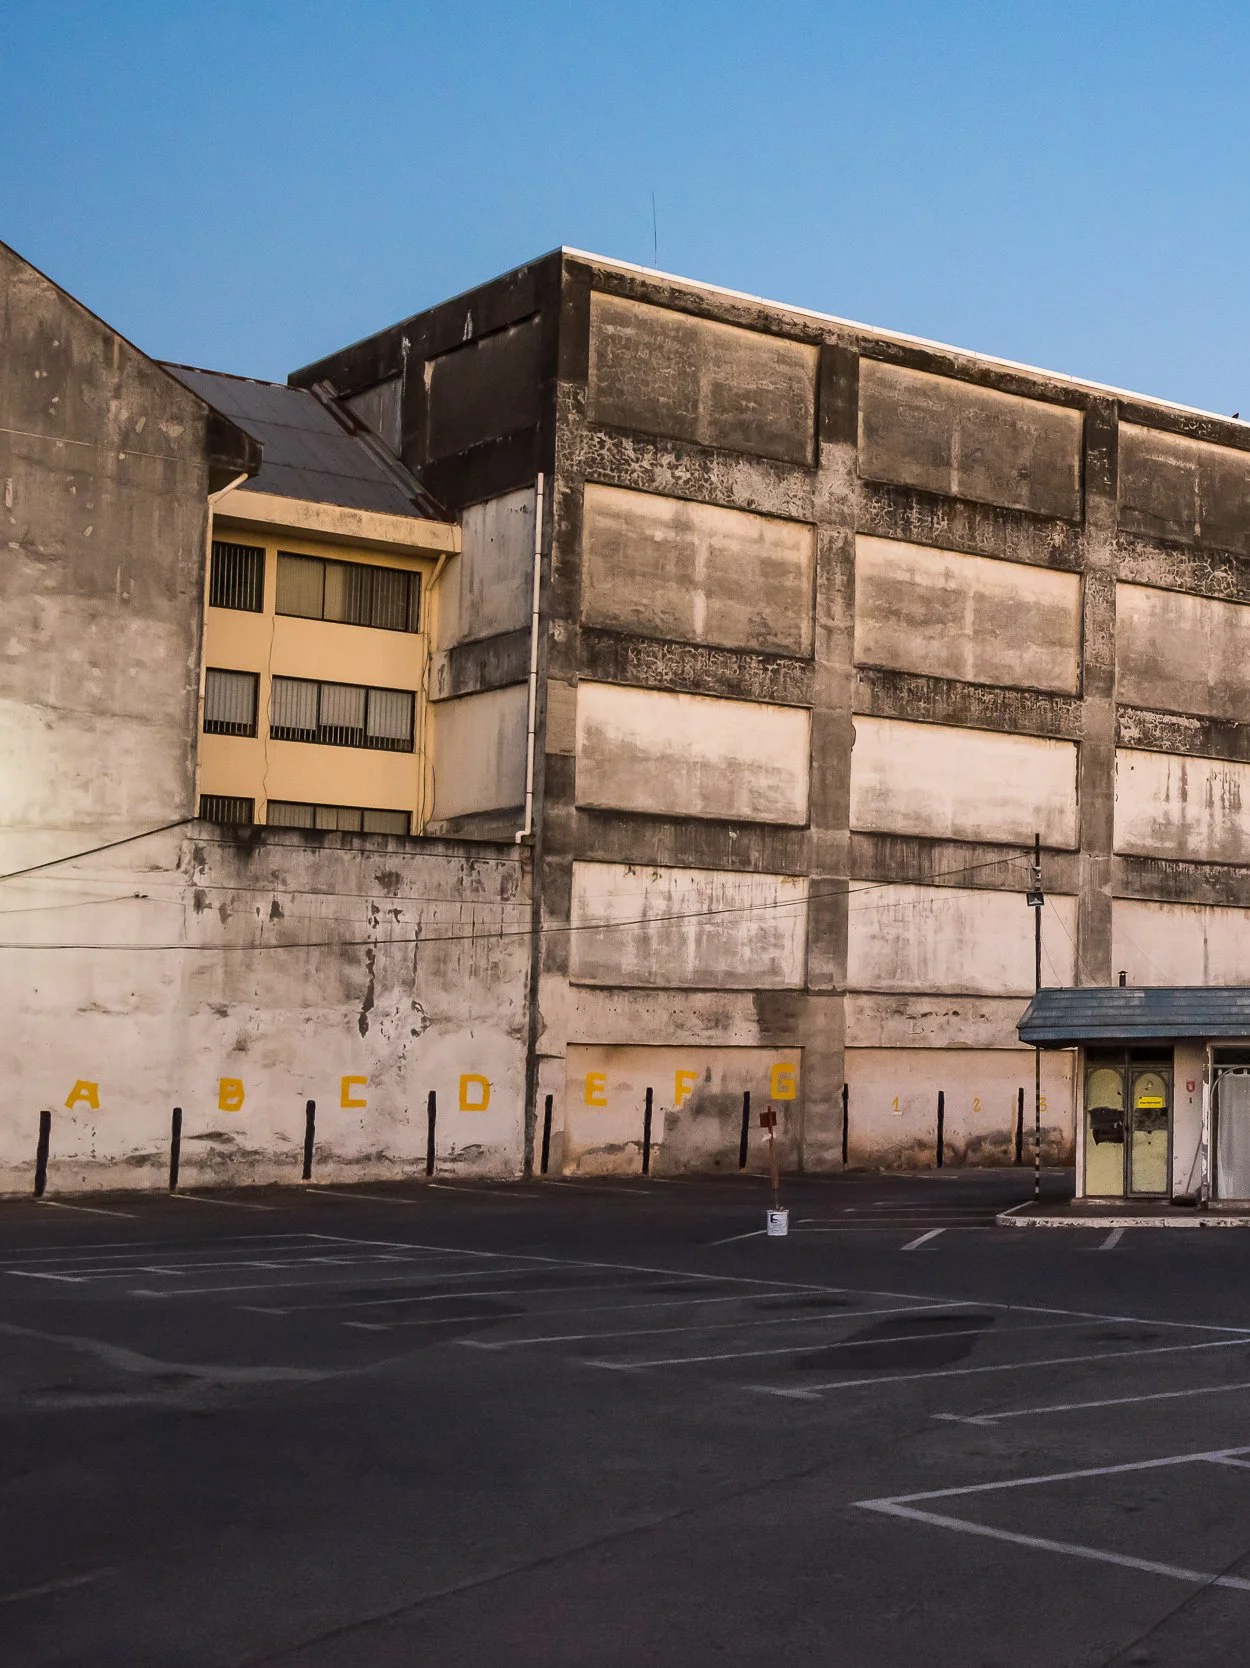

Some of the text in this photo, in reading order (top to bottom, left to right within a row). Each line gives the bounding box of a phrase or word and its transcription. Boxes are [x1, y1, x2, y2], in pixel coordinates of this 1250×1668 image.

[64, 1079, 101, 1109] A
[218, 1077, 246, 1112] B
[340, 1075, 368, 1109] C
[459, 1073, 492, 1112] D
[584, 1071, 608, 1107] E
[674, 1069, 698, 1106] F
[769, 1062, 798, 1101] G
[892, 1096, 900, 1112] 1
[973, 1097, 981, 1112] 2
[1039, 1097, 1047, 1112] 3
